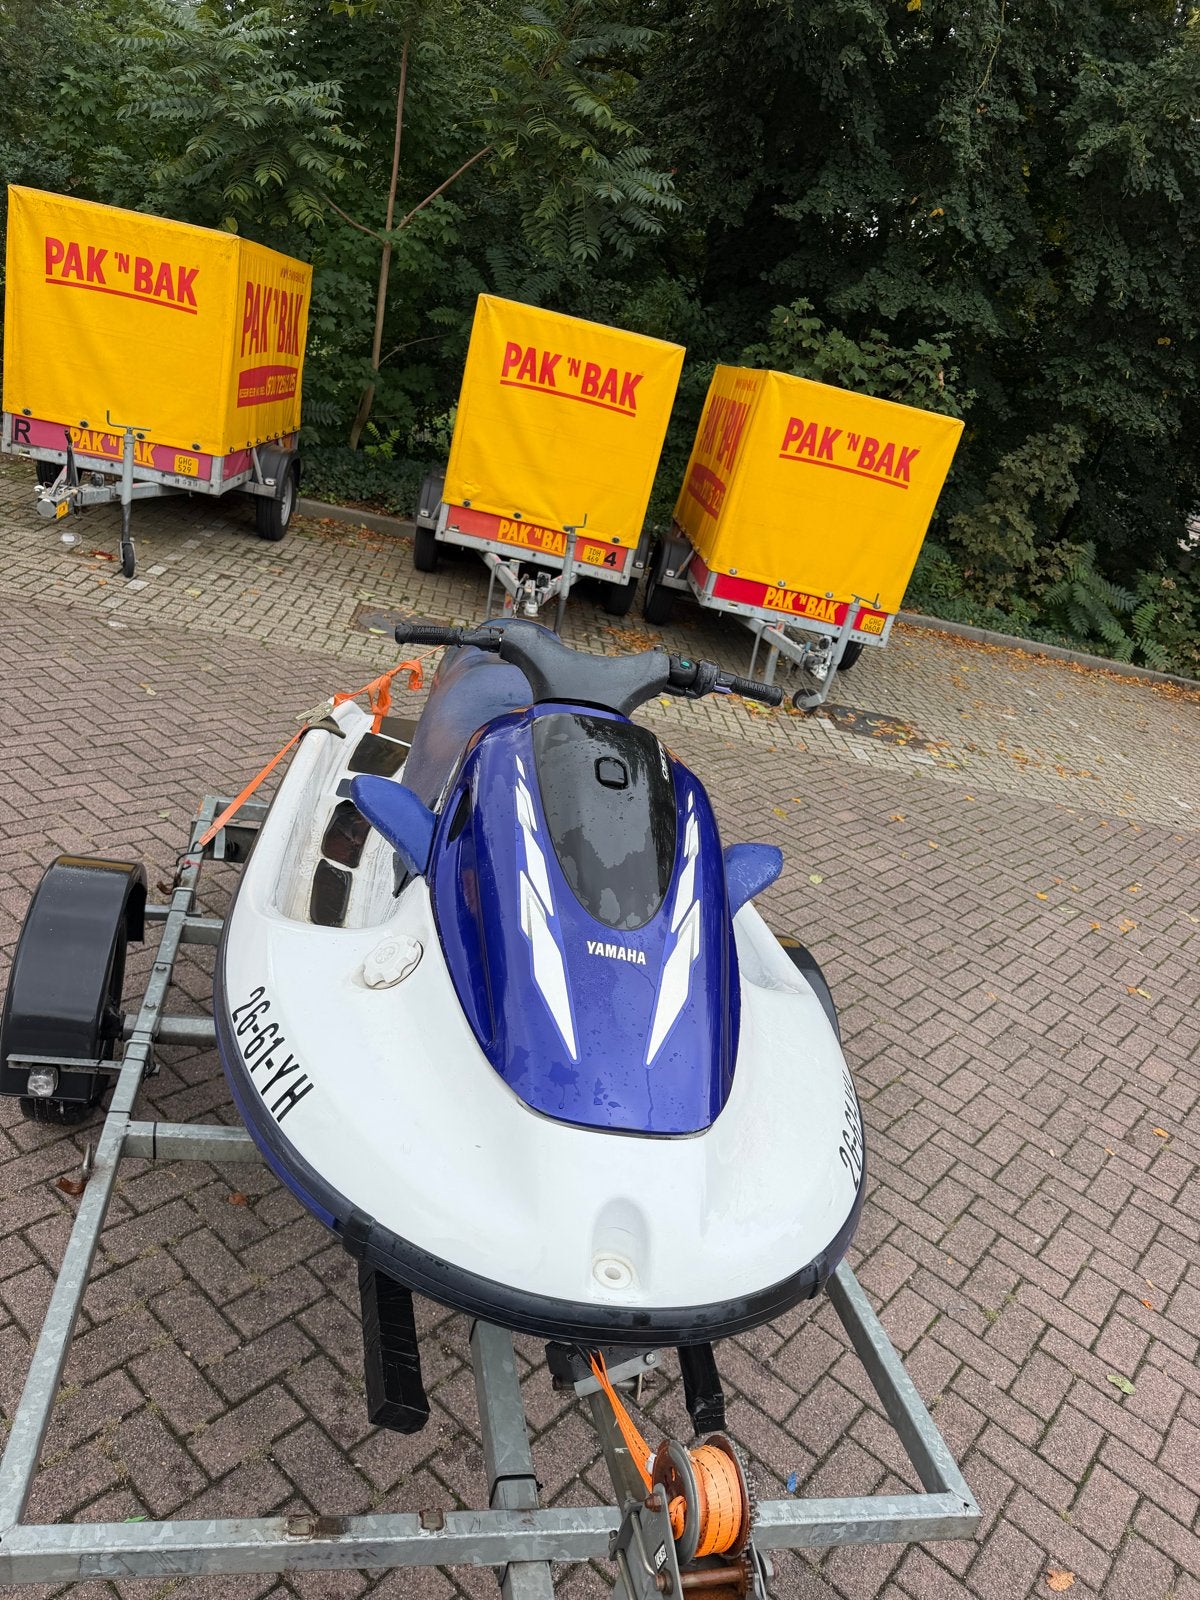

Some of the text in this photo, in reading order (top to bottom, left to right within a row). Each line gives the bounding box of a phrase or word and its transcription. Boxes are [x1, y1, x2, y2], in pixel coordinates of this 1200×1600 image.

[45, 236, 200, 307] PAK 'N BAK
[240, 281, 272, 358] PAK
[277, 290, 304, 357] BAK
[502, 341, 644, 410] PAK 'N BAK
[14, 418, 31, 444] R
[70, 427, 105, 452] PAK
[781, 416, 921, 482] PAK 'N BAK
[177, 464, 192, 474] 529
[178, 457, 193, 467] GHG
[498, 519, 532, 545] PAK
[586, 555, 599, 564] 469
[588, 547, 602, 557] TDH
[604, 551, 617, 567] 4
[763, 586, 798, 610] PAK
[805, 596, 841, 621] BAK
[416, 626, 444, 635] YAMAHA
[741, 679, 767, 693] YAMAHA
[586, 940, 647, 965] YAMAHA
[231, 986, 315, 1123] 26-61-YH
